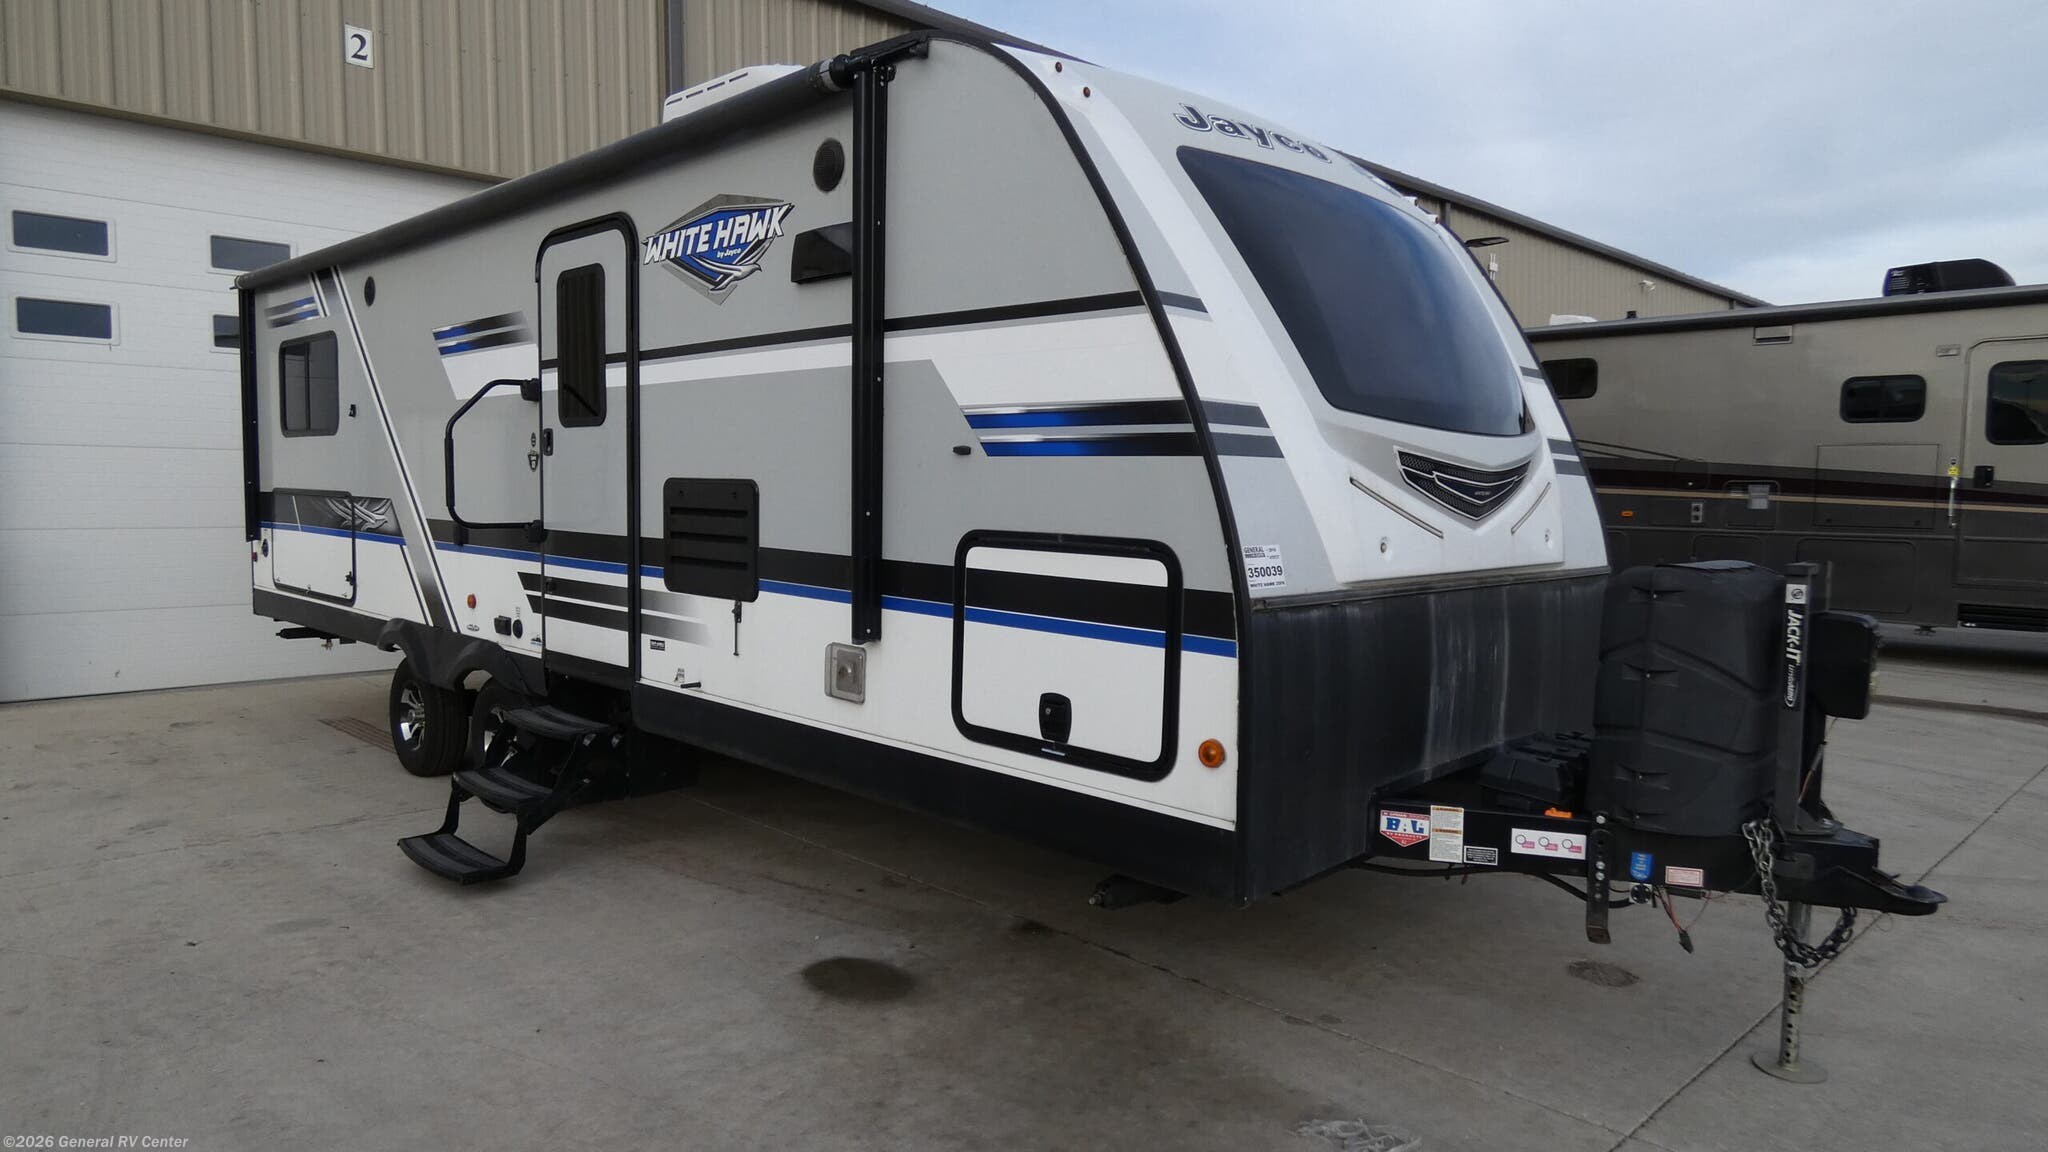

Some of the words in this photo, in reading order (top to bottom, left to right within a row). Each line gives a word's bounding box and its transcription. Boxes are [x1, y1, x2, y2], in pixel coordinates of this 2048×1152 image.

[350, 33, 368, 61] 2
[1173, 102, 1332, 164] Jayco
[643, 222, 713, 265] WHITE
[713, 203, 794, 250] HAWK
[1248, 566, 1282, 578] 350039
[1786, 609, 1803, 665] JACK-IT
